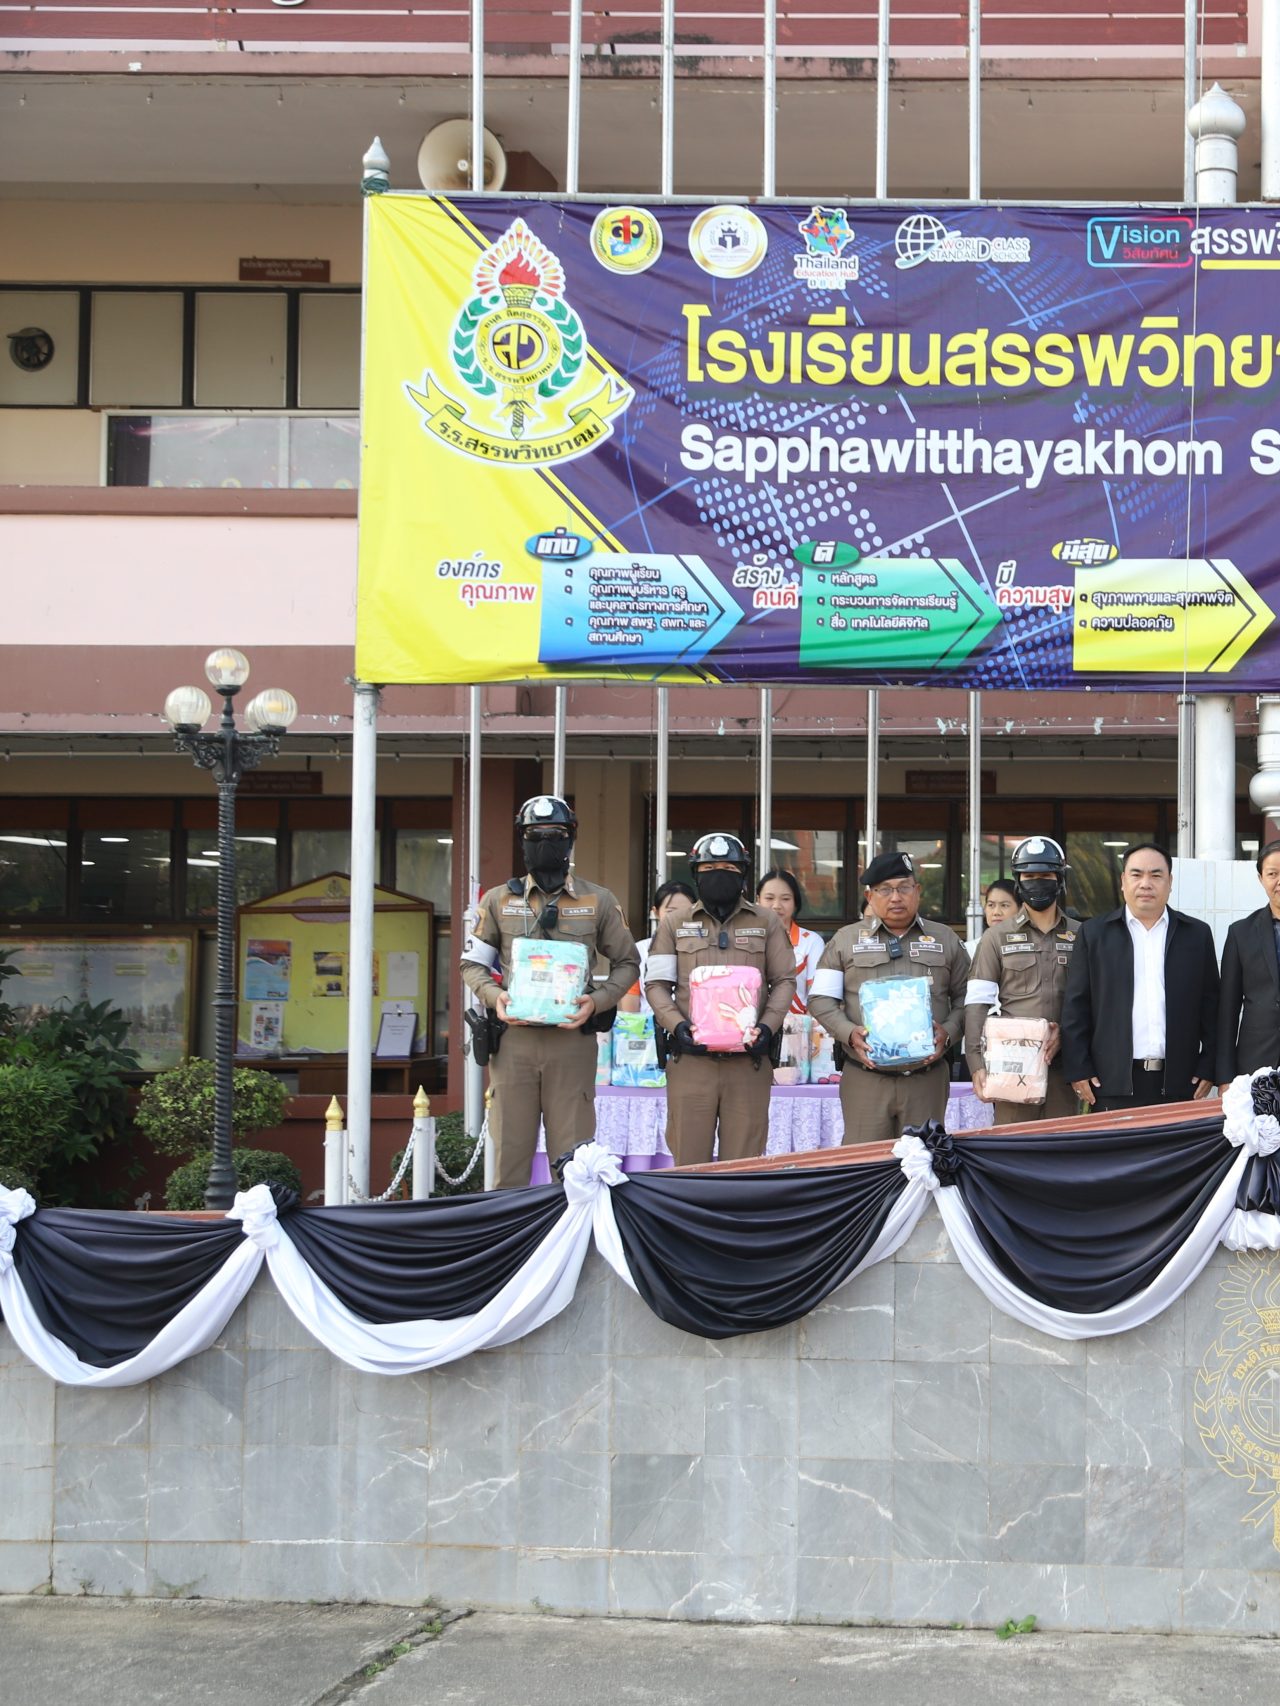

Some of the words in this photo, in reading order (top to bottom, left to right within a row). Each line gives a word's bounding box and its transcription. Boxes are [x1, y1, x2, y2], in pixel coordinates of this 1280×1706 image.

[1095, 224, 1180, 259] Vision
[797, 257, 857, 269] Thailand
[993, 250, 1029, 261] SCHOOL
[796, 269, 838, 279] Education
[840, 269, 857, 279] Hub
[438, 421, 601, 461] ร.ร.สรรพวิทยาคม
[680, 423, 1222, 489] Sapphawitthayakhom
[537, 527, 578, 555] เก่ง
[813, 541, 836, 563] ดี
[1062, 538, 1110, 564] มีสุข
[437, 552, 500, 578] องค์กร
[734, 555, 781, 586] สร้าง
[997, 563, 1015, 585] มี
[831, 573, 876, 587] หลักสูตร
[461, 584, 535, 607] คุณภาพ
[755, 585, 797, 607] คนดี
[831, 592, 957, 610] กระบวนการจัดการเรียนรู้
[1000, 587, 1072, 612] ความสุข
[1091, 590, 1233, 608] สุขภาพกายและสุขภาพจิต
[589, 616, 629, 630] คุณภาพ
[830, 613, 846, 628] สื่อ
[851, 615, 928, 629] เทคโนโลยีดิจิทัล
[1091, 616, 1174, 630] ความปลอดภัย
[588, 630, 642, 644] สถานศึกษา
